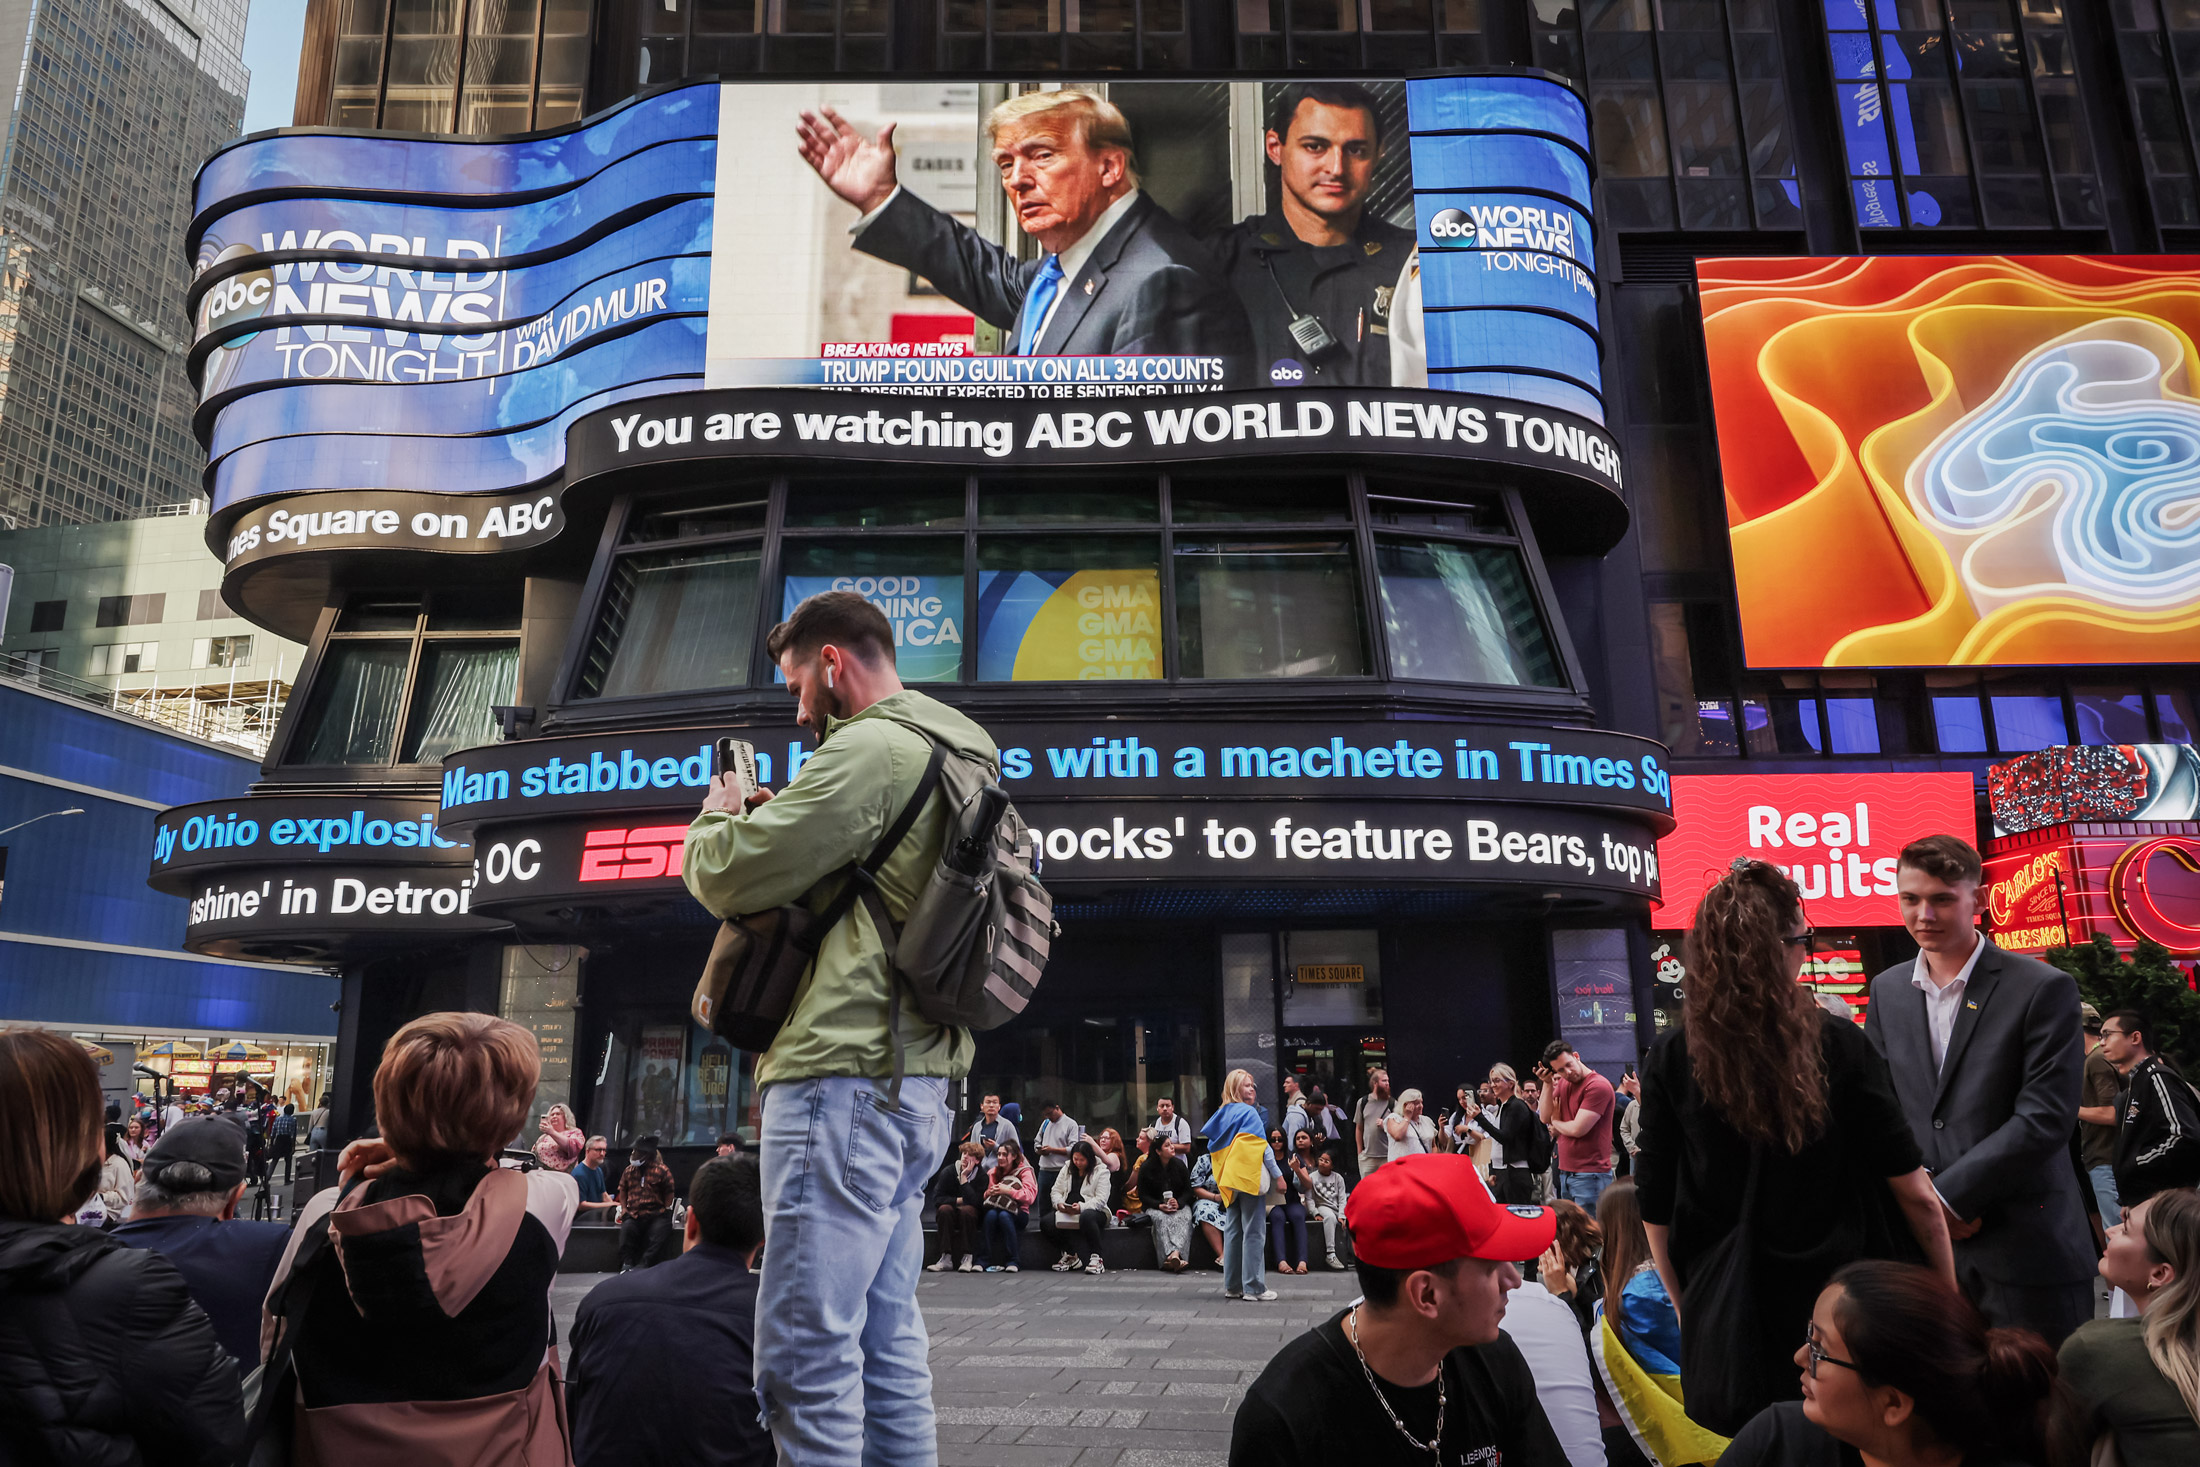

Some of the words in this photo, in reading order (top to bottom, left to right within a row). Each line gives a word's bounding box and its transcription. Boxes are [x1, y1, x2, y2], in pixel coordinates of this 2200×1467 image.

[1430, 218, 1476, 237] abc
[1470, 206, 1569, 236] WORLD
[1478, 227, 1571, 258] NEWS
[262, 230, 498, 291] WORLD
[1481, 252, 1571, 281] TONIGHT
[210, 273, 273, 319] abc
[591, 277, 667, 330] MUIR
[274, 284, 494, 351] NEWS
[515, 310, 554, 342] WITH
[275, 342, 495, 383] TONIGHT
[823, 343, 910, 357] BREAKING
[913, 343, 964, 357] NEWS
[821, 360, 890, 383] TRUMP
[894, 359, 964, 382] FOUND
[969, 359, 1038, 382] GUILTY
[1041, 359, 1071, 381] ON
[1075, 359, 1110, 381] ALL
[1114, 358, 1138, 381] 34
[1142, 358, 1224, 381] COUNTS
[1271, 366, 1303, 382] abc
[1029, 385, 1049, 398] TO
[1054, 385, 1072, 398] BE
[610, 414, 692, 453] You
[704, 412, 781, 440] are
[793, 410, 1013, 457] watching
[1025, 411, 1132, 448] ABC
[1144, 401, 1334, 446] WORLD
[1348, 401, 1488, 444] NEWS
[266, 509, 399, 545] Square
[411, 512, 468, 539] on
[477, 496, 553, 539] ABC
[831, 577, 920, 597] GOOD
[1077, 585, 1153, 609] GMA
[881, 597, 942, 617] NING
[895, 617, 961, 647] ICA
[1077, 611, 1154, 636] GMA
[1078, 638, 1155, 662] GMA
[441, 765, 509, 810] Man
[521, 744, 712, 798] stabbed
[1046, 737, 1159, 778] with
[1173, 746, 1206, 778] a
[1221, 737, 1443, 779] machete
[1455, 739, 1499, 781] in
[1509, 741, 1636, 789] Times
[1641, 755, 1670, 808] Sq
[181, 813, 260, 852] Ohio
[1748, 803, 1870, 848] Real
[485, 838, 542, 884] OC
[1203, 818, 1257, 860] to
[1270, 817, 1453, 861] feature
[1467, 819, 1595, 876] Bears,
[1601, 833, 1641, 883] top
[280, 880, 317, 915] in
[331, 879, 472, 915] Detroi
[1990, 851, 2059, 926] CARLO'S
[2029, 886, 2048, 906] SINCE
[2049, 883, 2057, 893] 19
[2025, 913, 2045, 923] TIMES
[2046, 911, 2070, 922] SQUAE
[1300, 967, 1326, 979] TIMES
[1329, 967, 1361, 979] SQUARE
